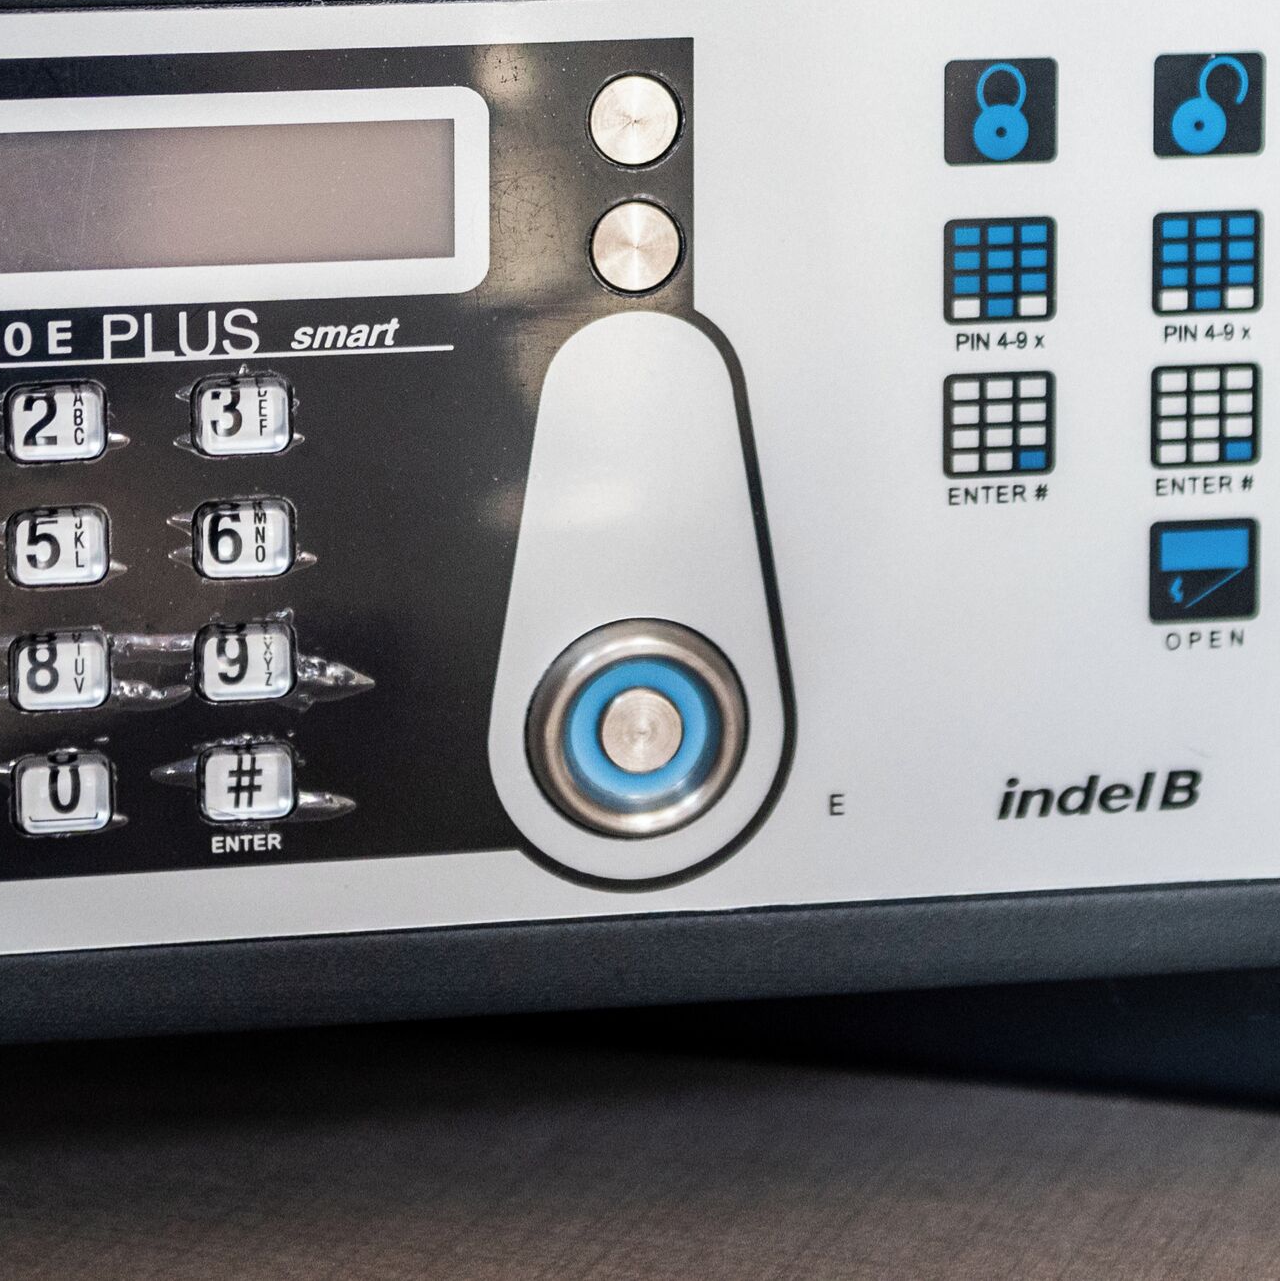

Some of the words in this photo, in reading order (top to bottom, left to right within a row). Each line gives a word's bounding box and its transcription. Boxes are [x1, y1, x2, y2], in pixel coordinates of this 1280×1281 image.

[47, 319, 73, 355] E
[102, 309, 261, 361] PLUS
[290, 317, 401, 350] smart
[954, 331, 991, 352] PIN
[996, 329, 1029, 350] 4-9
[1162, 322, 1199, 343] PIN
[1203, 322, 1236, 342] 4-9
[22, 393, 58, 446] 2
[210, 386, 244, 438] 3
[947, 484, 1027, 507] ENTER
[1033, 483, 1050, 502] #
[1154, 473, 1233, 497] ENTER
[1239, 474, 1255, 492] #
[25, 518, 62, 570] 5
[207, 513, 243, 565] 6
[216, 628, 249, 686] 9
[1164, 628, 1245, 652] OPEN
[26, 634, 60, 694] 8
[827, 793, 846, 817] E
[210, 832, 283, 855] ENTER
